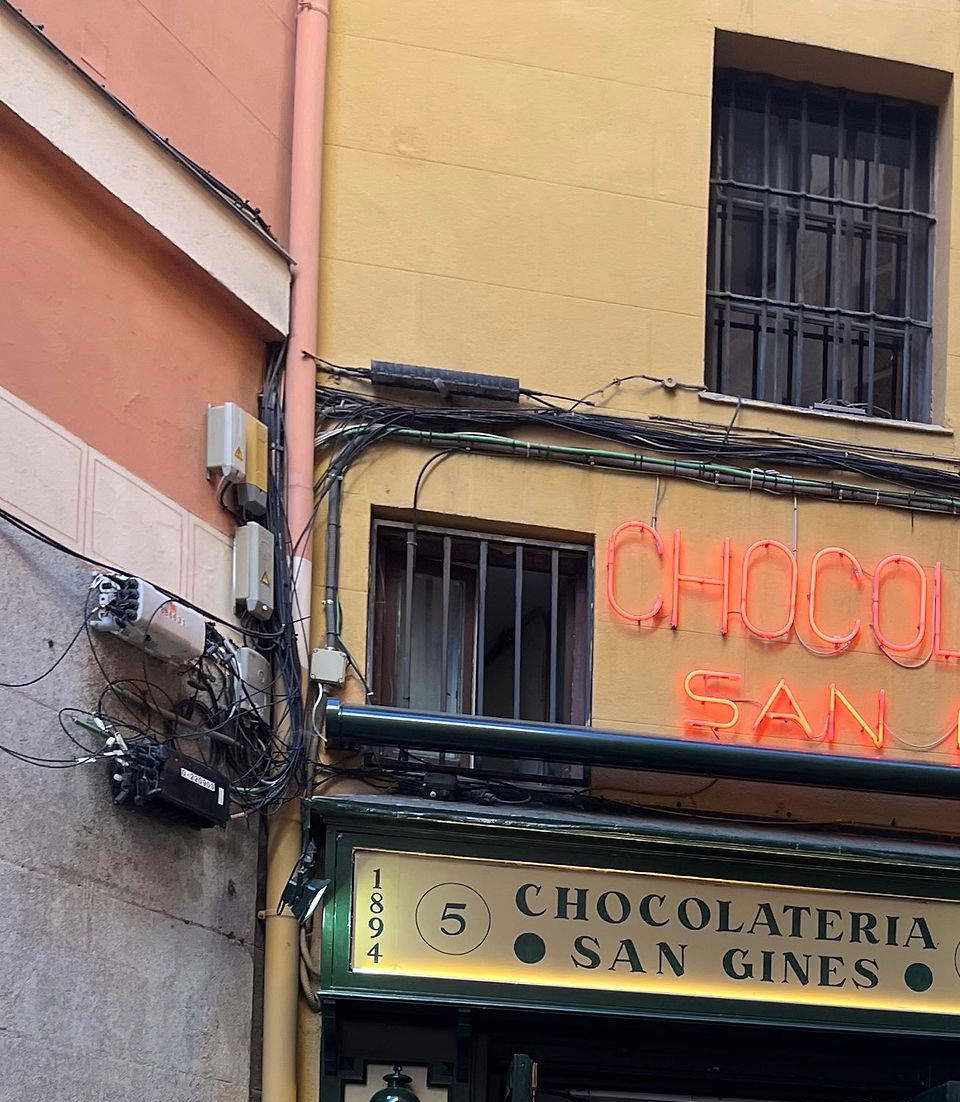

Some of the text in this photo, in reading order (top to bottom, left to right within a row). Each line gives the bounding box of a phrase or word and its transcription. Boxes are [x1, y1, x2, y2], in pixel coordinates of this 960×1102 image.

[684, 669, 886, 748] SAN
[366, 868, 384, 964] 1894
[440, 903, 467, 936] 5
[515, 883, 938, 950] CHOCOLATERIA
[571, 935, 880, 989] SAN GINES
